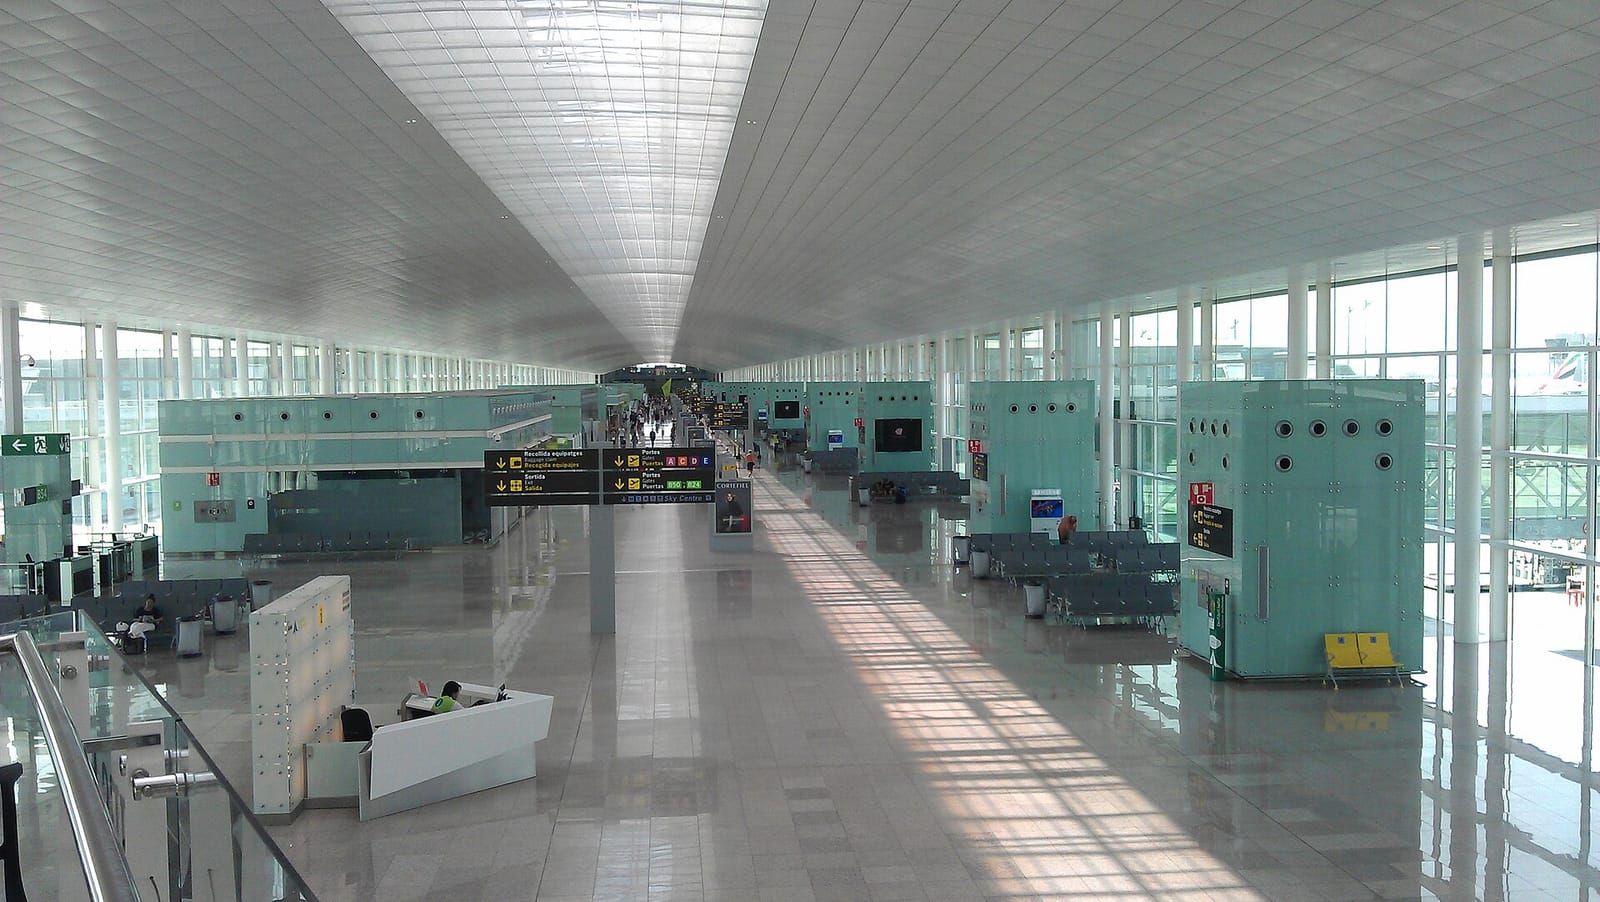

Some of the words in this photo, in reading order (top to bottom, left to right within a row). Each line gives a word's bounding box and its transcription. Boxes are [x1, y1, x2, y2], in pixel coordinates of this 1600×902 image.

[668, 457, 674, 465] A
[679, 457, 686, 465] C
[691, 457, 698, 465] D
[703, 457, 709, 465] E
